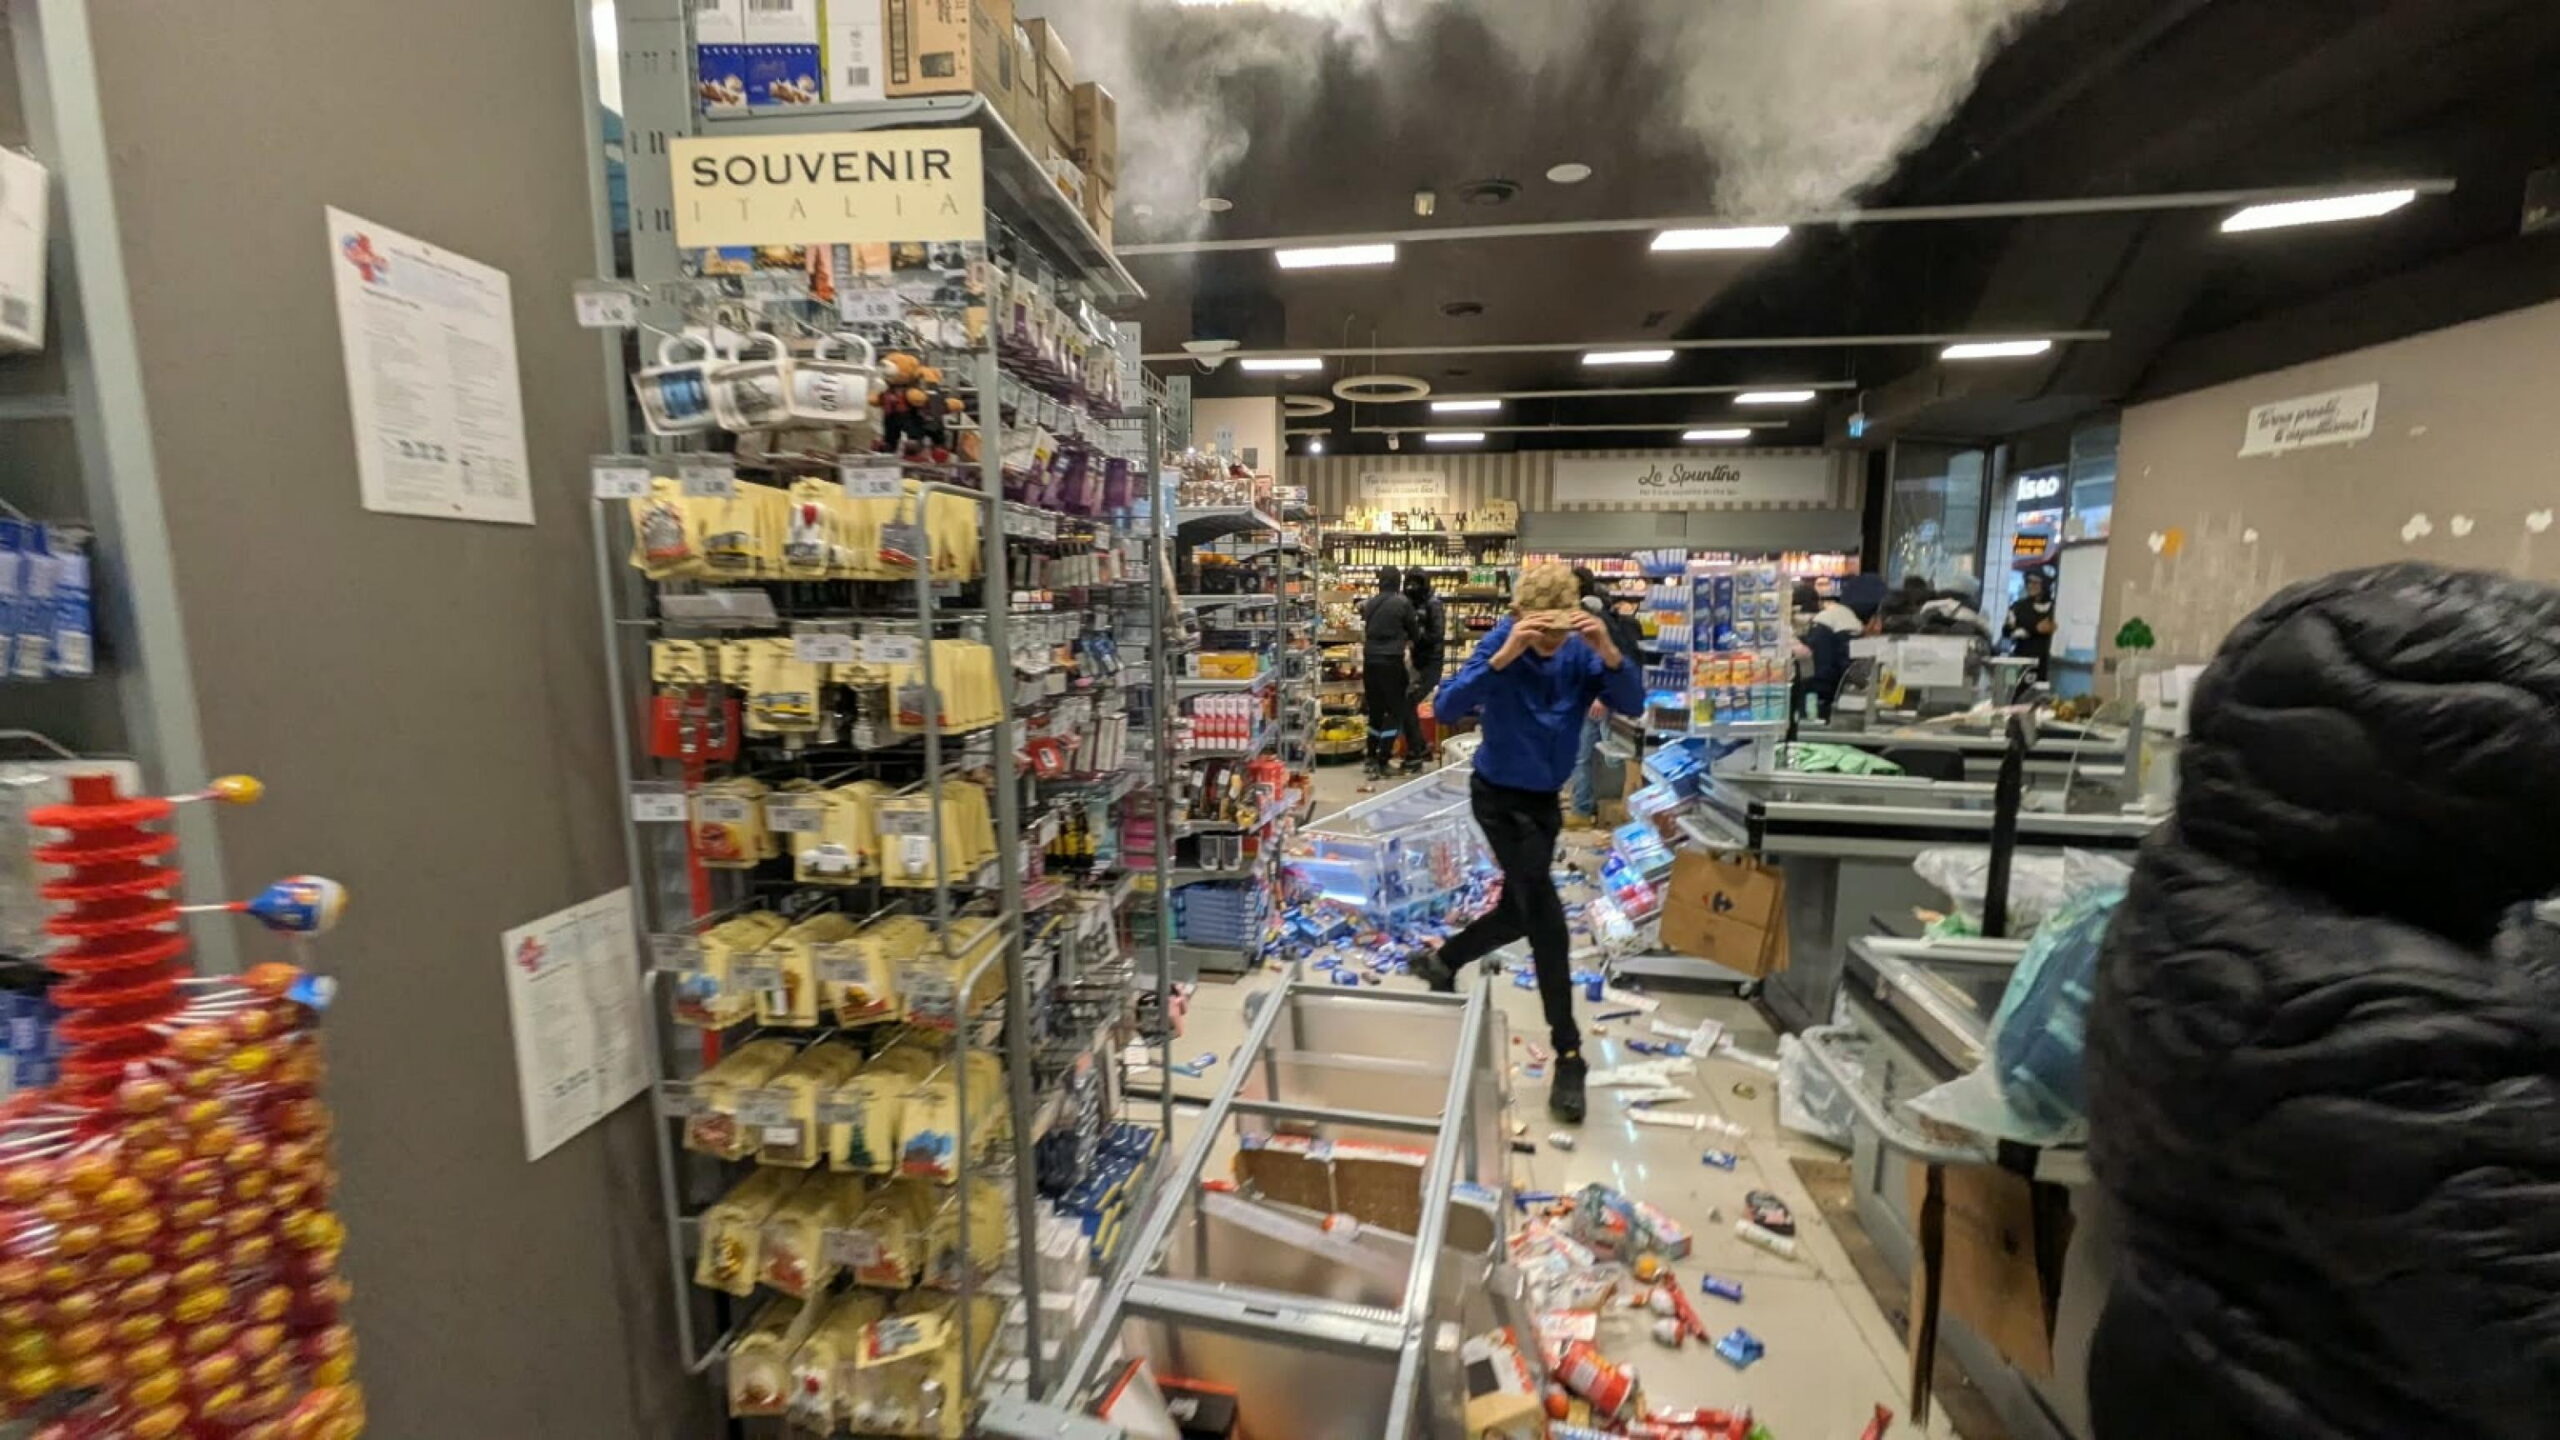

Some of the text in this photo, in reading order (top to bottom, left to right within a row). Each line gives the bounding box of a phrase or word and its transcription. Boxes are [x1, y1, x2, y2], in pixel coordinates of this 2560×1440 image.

[692, 149, 952, 187] SOUVENIR
[693, 193, 959, 222] ITALIA
[1669, 463, 1741, 487] Spuntino
